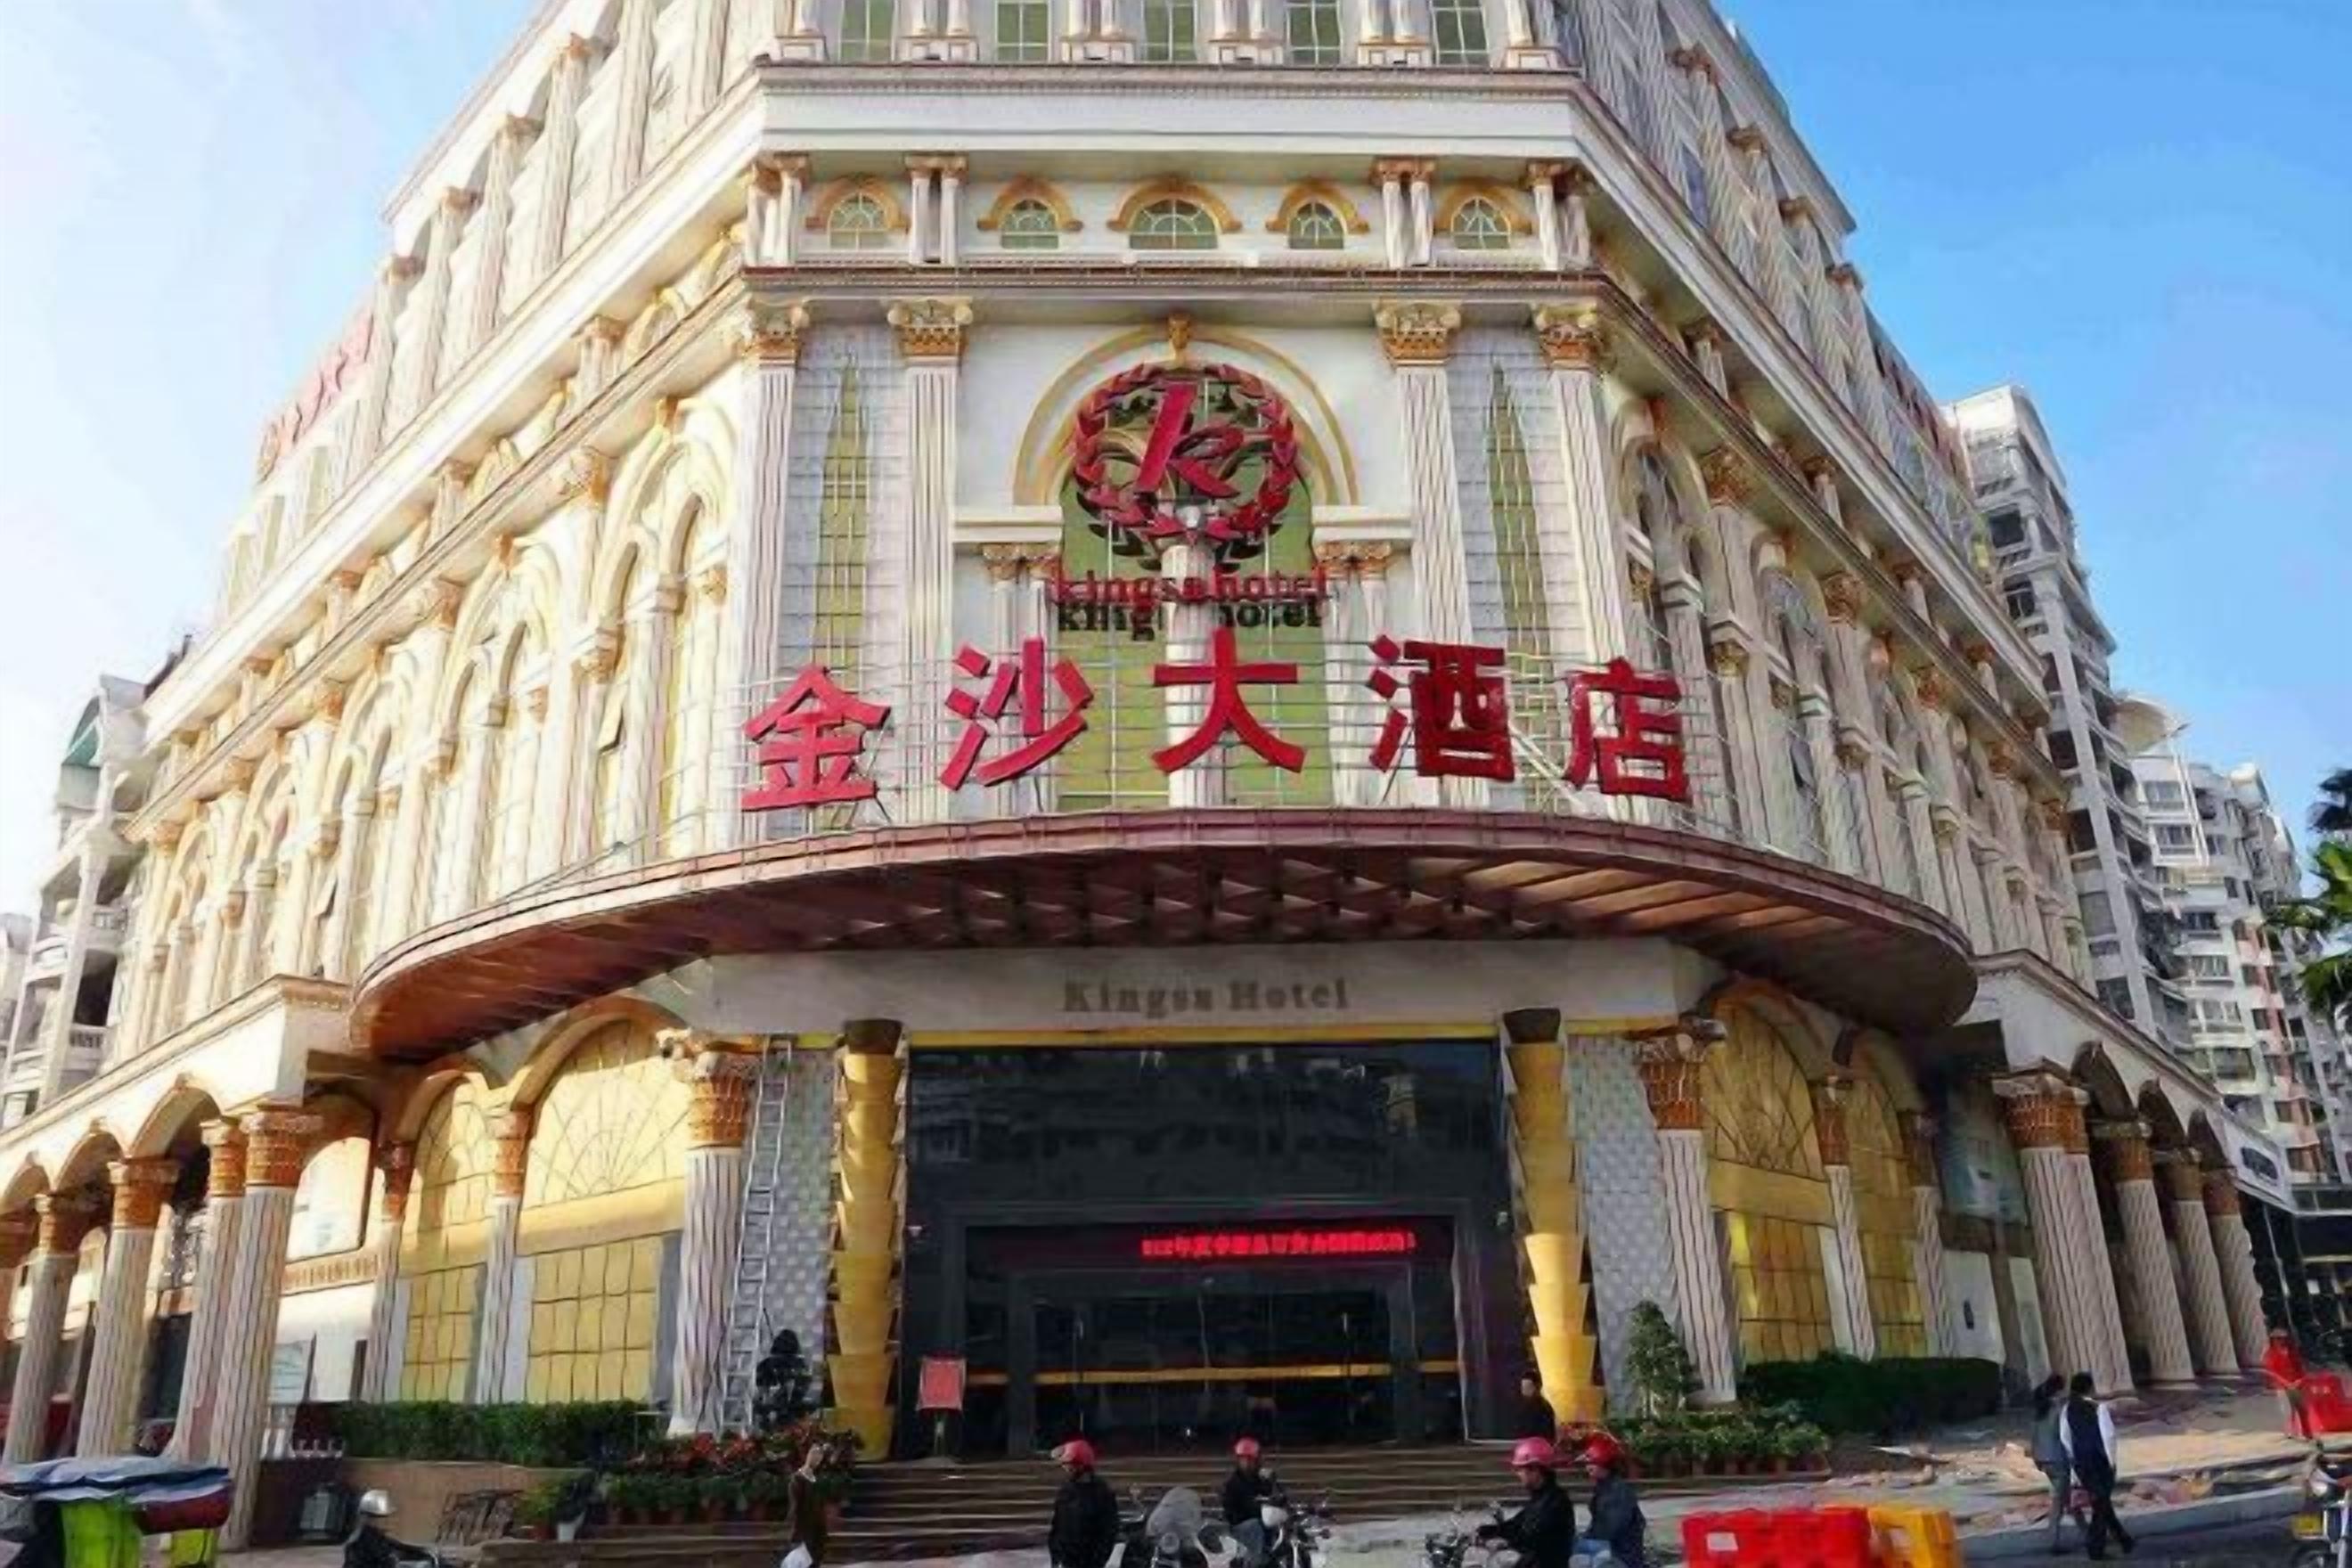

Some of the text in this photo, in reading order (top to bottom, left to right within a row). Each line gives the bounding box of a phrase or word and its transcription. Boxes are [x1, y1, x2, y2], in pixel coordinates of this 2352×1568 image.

[1213, 563, 1325, 602] hotel
[741, 625, 1690, 812] 金沙大酒店
[1229, 978, 1349, 1011] Hotel
